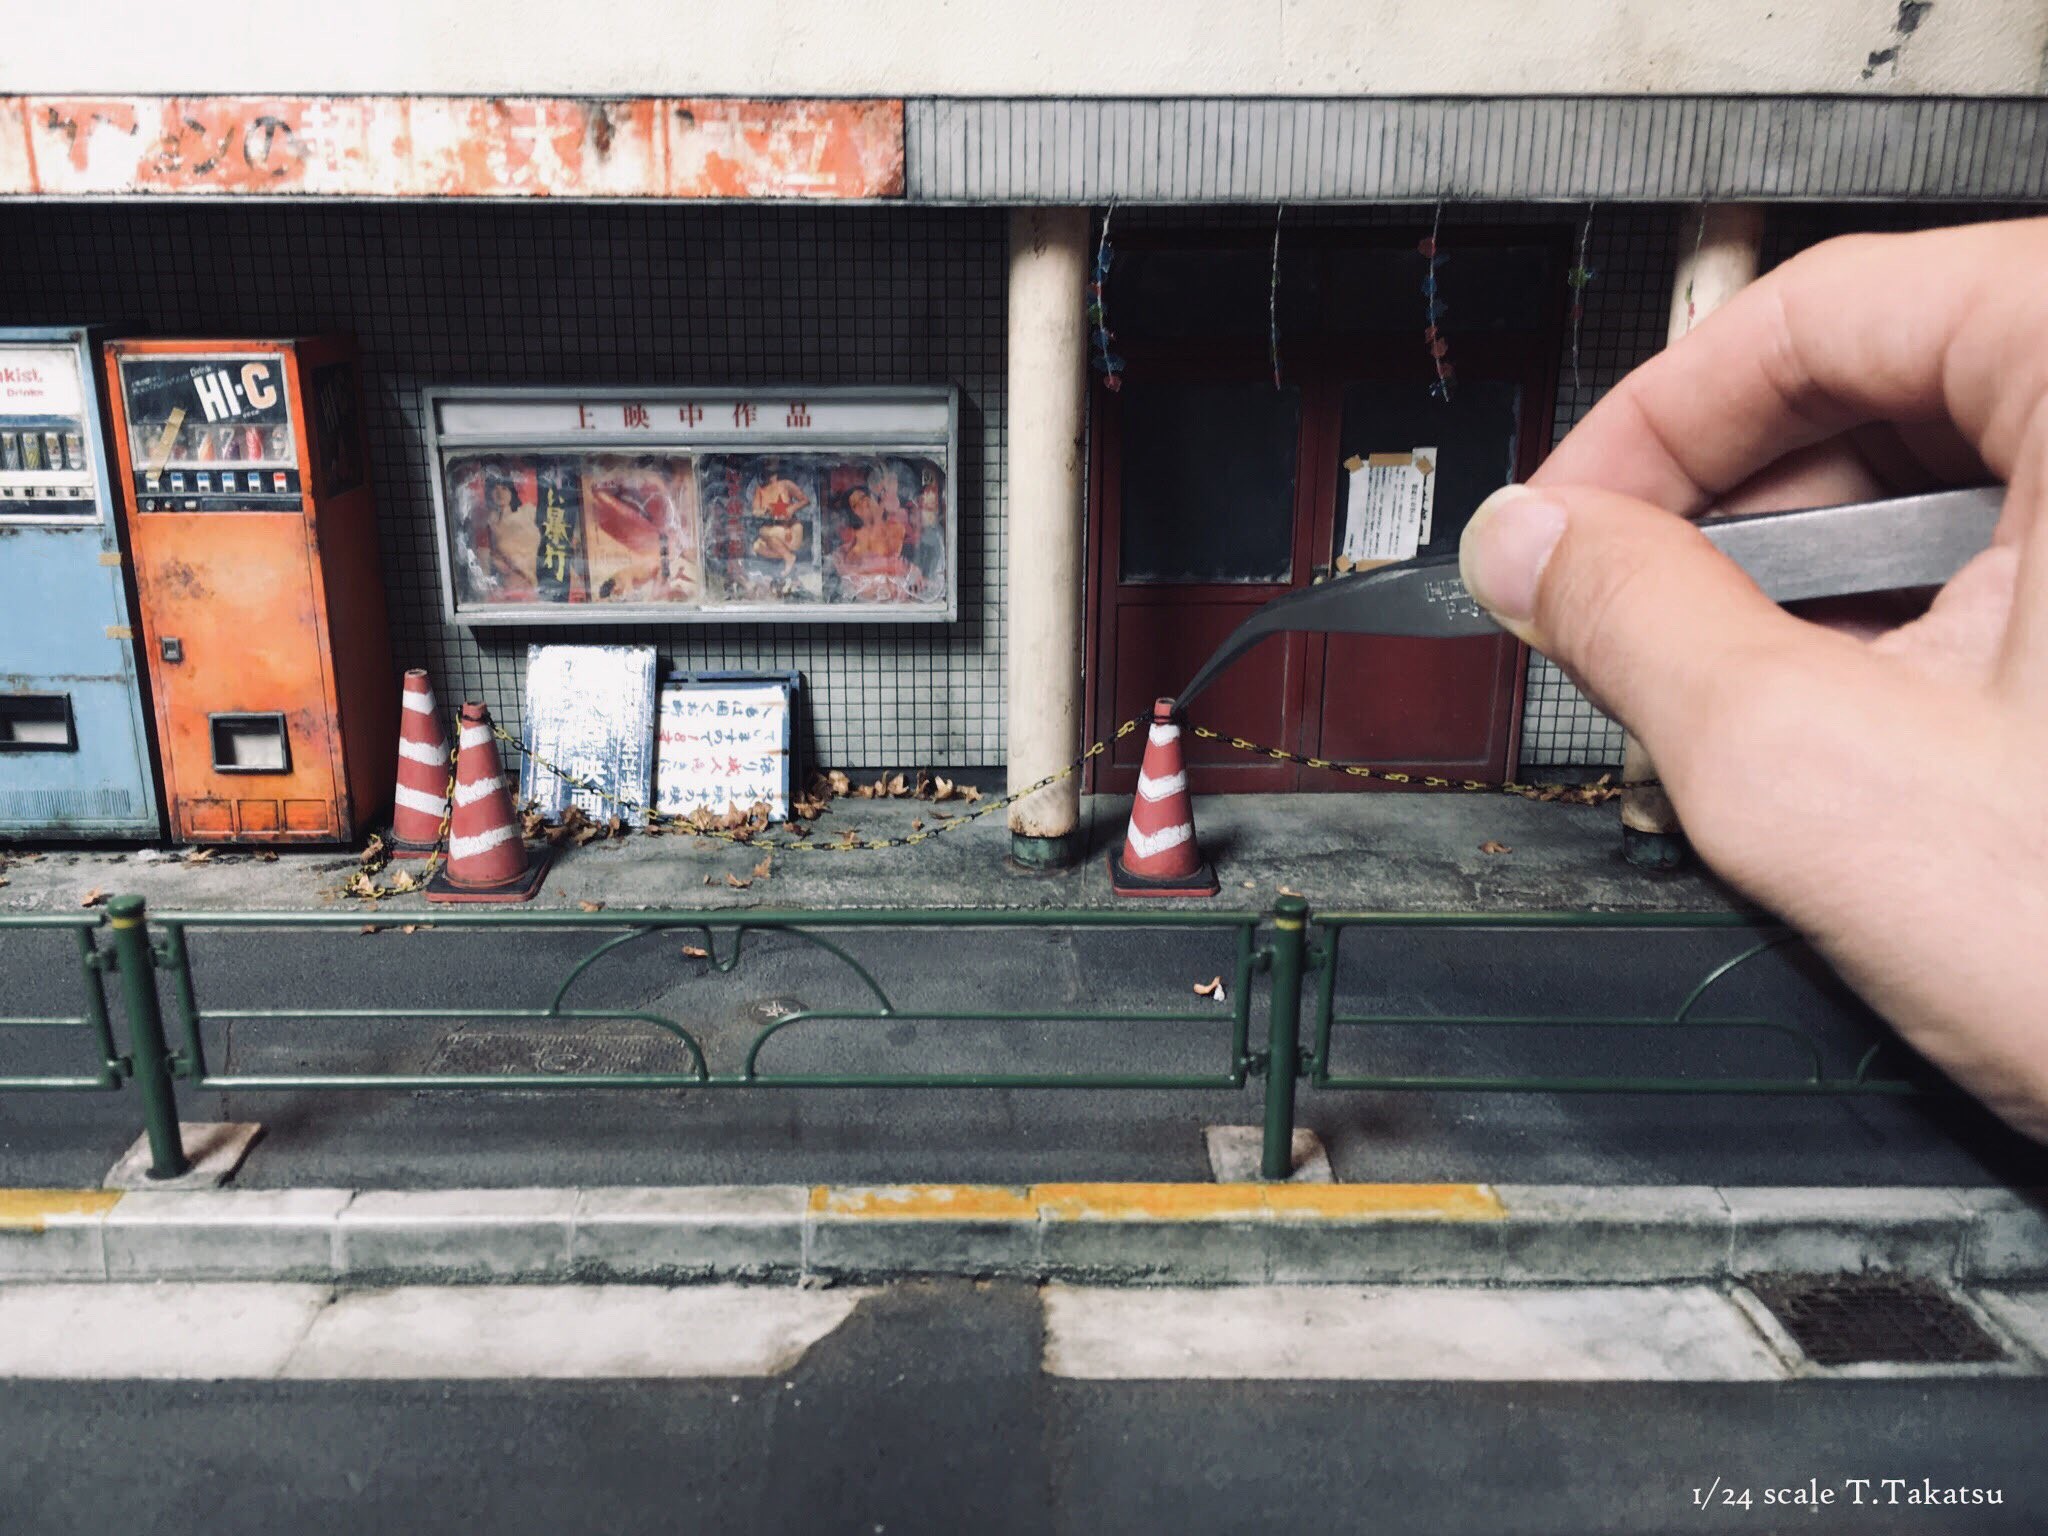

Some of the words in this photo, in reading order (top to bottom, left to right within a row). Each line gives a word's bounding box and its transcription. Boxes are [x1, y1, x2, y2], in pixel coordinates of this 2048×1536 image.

[0, 368, 39, 382] kist
[572, 402, 811, 430] 上映中作品
